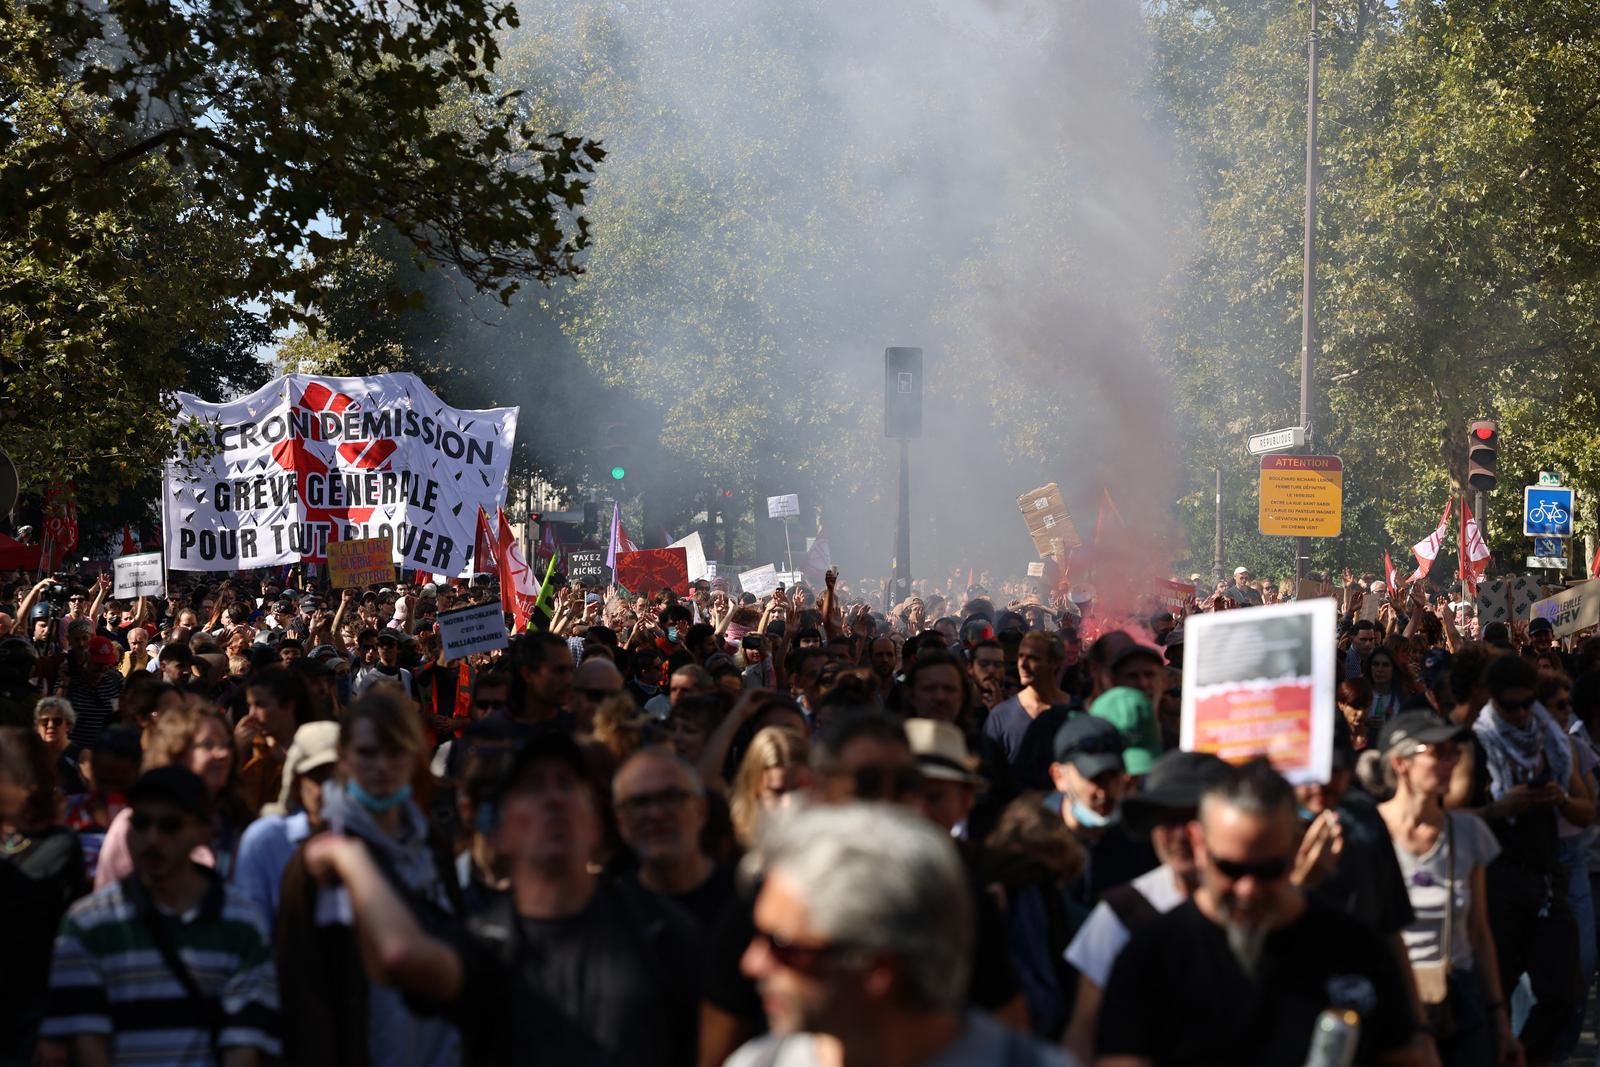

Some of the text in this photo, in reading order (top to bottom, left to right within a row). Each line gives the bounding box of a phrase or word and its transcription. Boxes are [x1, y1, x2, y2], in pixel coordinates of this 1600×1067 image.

[320, 402, 494, 466] DÉMISSION
[1260, 432, 1291, 447] RÉPUBLIQUE
[1275, 458, 1329, 467] ATTENTION
[214, 467, 439, 513] GRÈVE GÉNÉRALE
[180, 527, 258, 561] POUR
[270, 521, 330, 556] TOUT
[572, 553, 601, 562] TAXEZ
[572, 566, 602, 576] RICHES
[443, 617, 464, 626] NOTRE
[447, 632, 503, 649] MILLIARDAIRES
